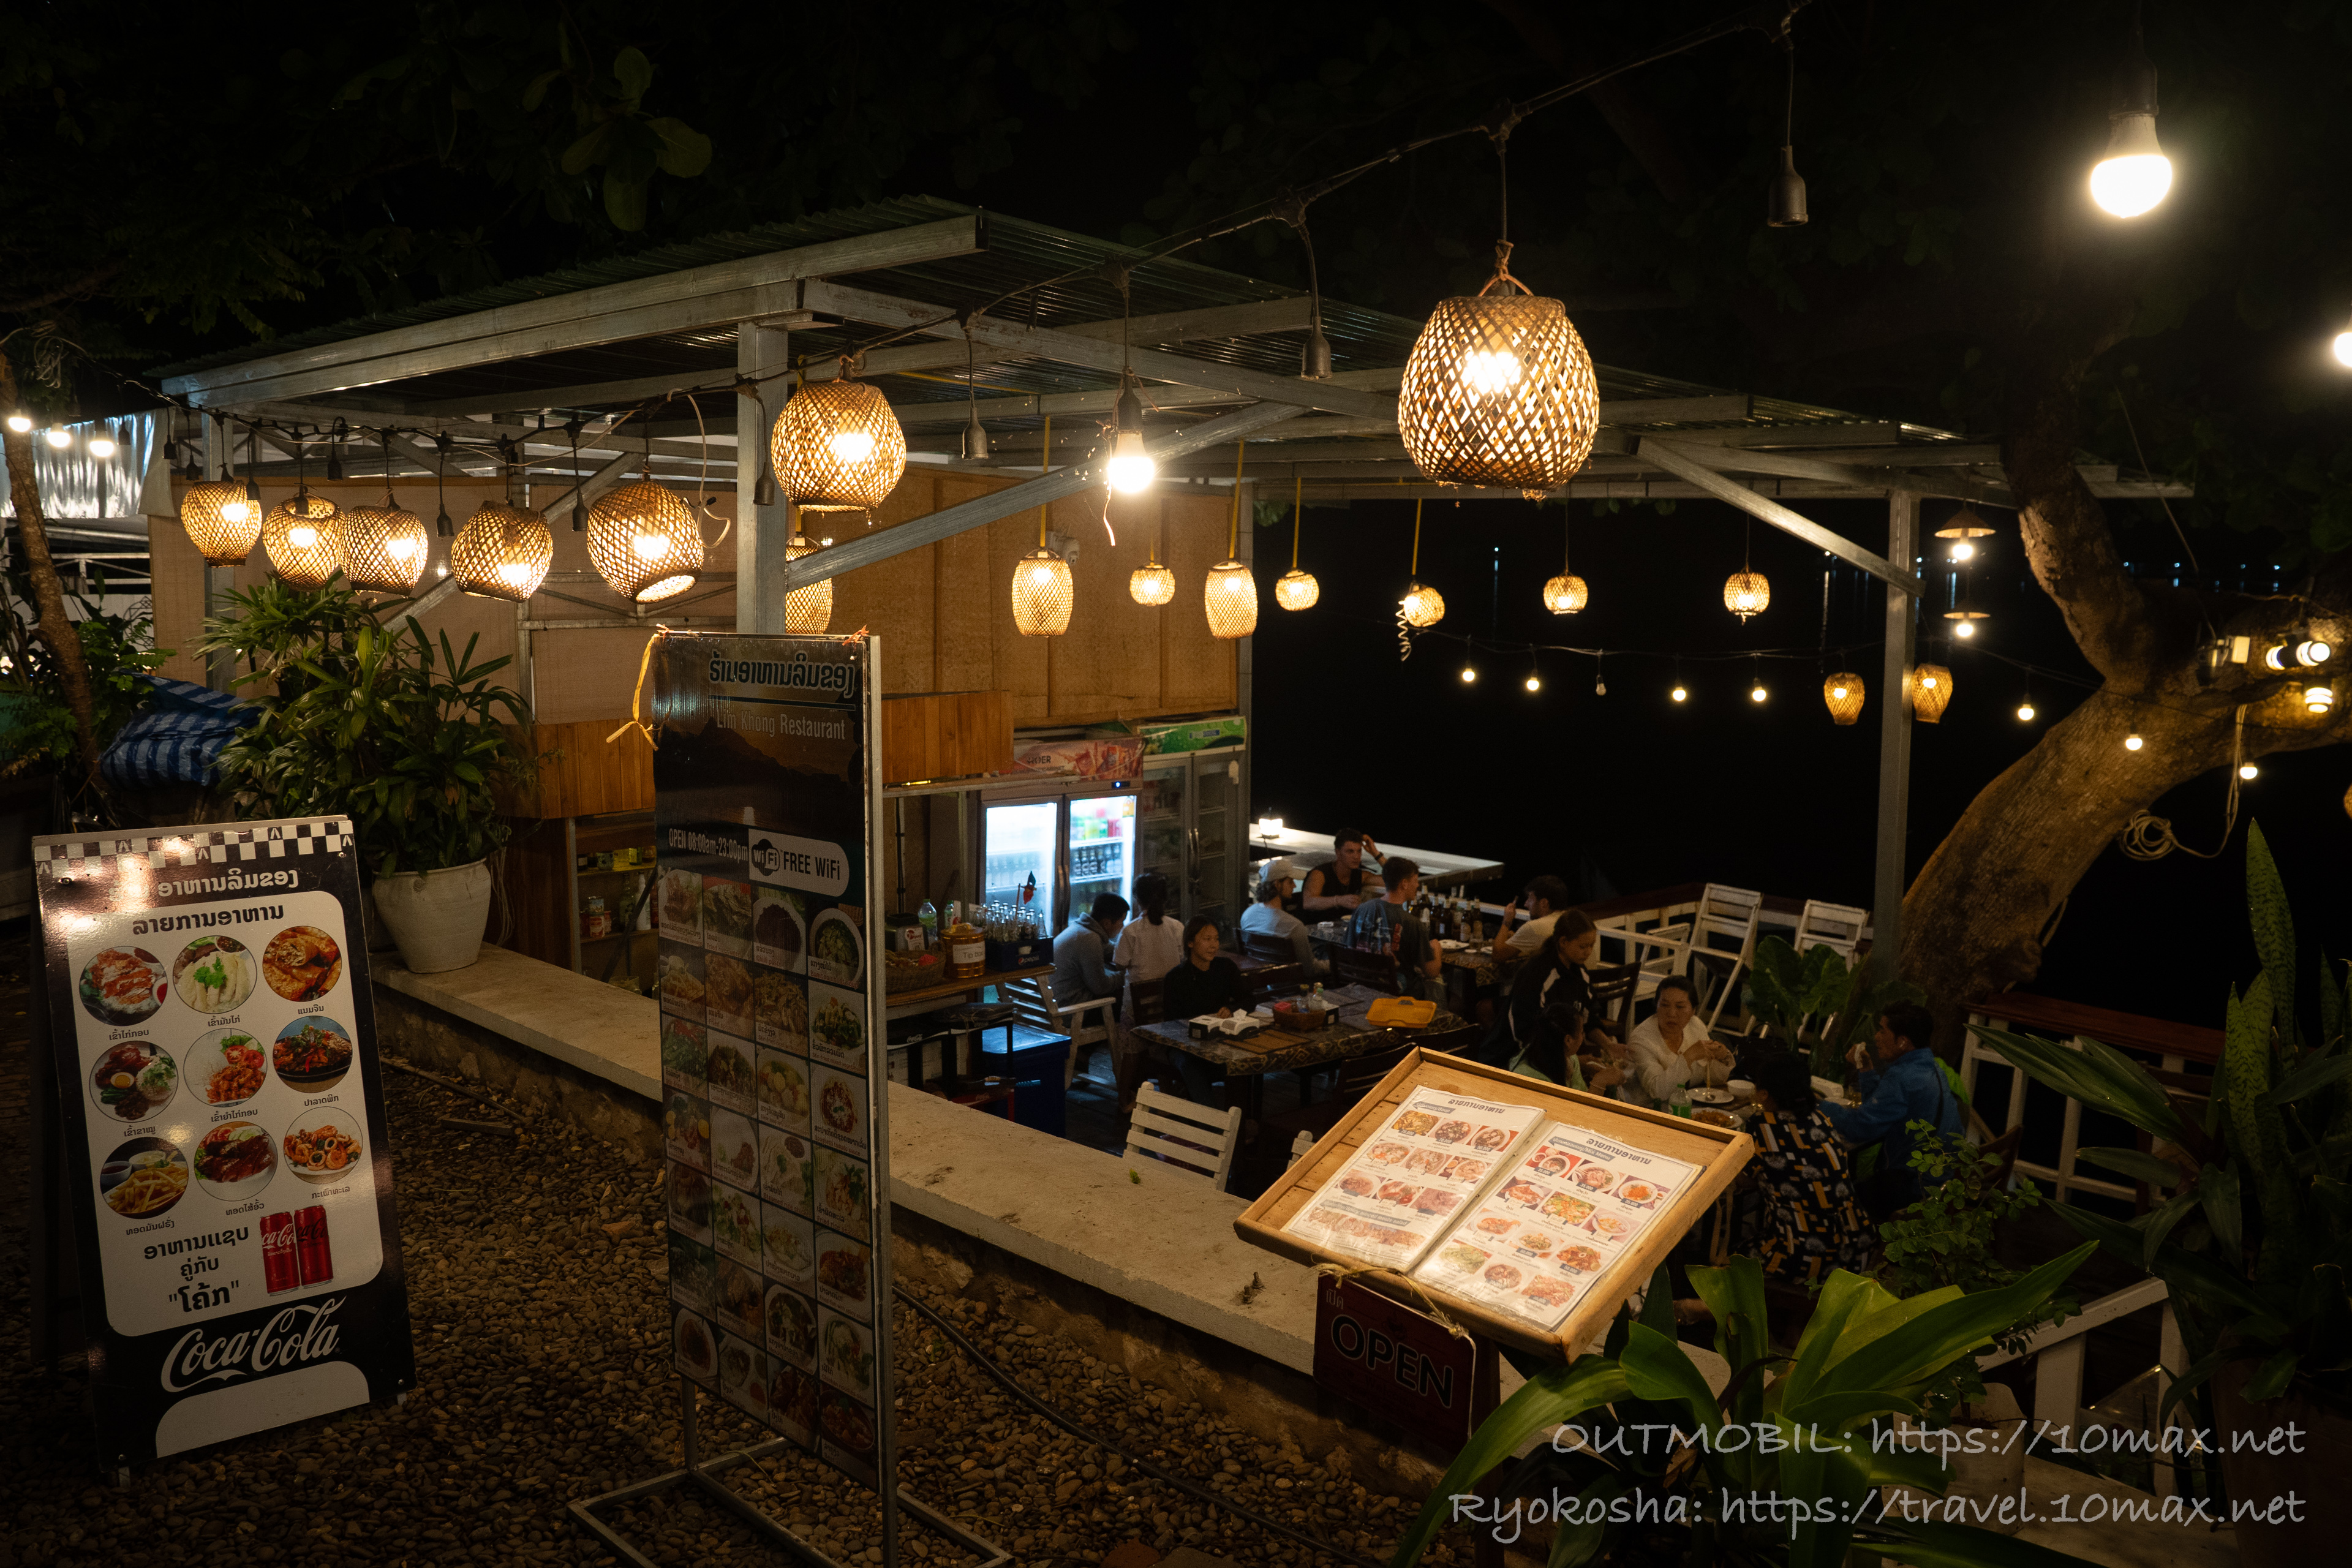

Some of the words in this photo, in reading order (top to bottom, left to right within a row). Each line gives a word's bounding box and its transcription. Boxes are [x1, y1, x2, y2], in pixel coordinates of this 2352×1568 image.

[708, 648, 856, 698] ຮ້ານອາຫານລິມຂອງ
[717, 710, 737, 729] Lim
[741, 710, 775, 737] Khong
[780, 714, 846, 740] Restaurant
[669, 827, 687, 848] OPEN
[688, 831, 748, 862] 08:00am-23:00pm
[783, 851, 811, 875] FREE
[815, 858, 841, 881] WiFi
[157, 867, 299, 897] ອາຫານລິມຂອງ
[132, 905, 284, 935] ລາຍການອາຫານ
[208, 1014, 241, 1027] ເຂົ້າມັນໄກ່
[109, 1028, 149, 1041] ເຂົ້າໄກ່ກອບ
[304, 1093, 339, 1106] ປາລາດພິກ
[1448, 1099, 1506, 1114] ລາຍການອາຫານ
[211, 1109, 258, 1122] ເຂົ້າຍຳໄກ່ກອບ
[124, 1125, 156, 1137] ເຂົ້າຂາໝູ
[1586, 1137, 1652, 1165] ລາຍການອາຫານ
[1595, 1151, 1611, 1161] Menu
[311, 1185, 350, 1199] ກະເພົາທະເລ
[225, 1199, 265, 1216] ທອດໄສ້ອົ້ວ
[126, 1216, 175, 1235] ທອດມັນຝຣັ່ງ
[144, 1226, 249, 1259] ອາຫານແຊບ
[181, 1256, 219, 1281] ຄູ່ກັບ
[168, 1280, 239, 1312] "ໂຄ້ກ"
[160, 1295, 347, 1393] Coca-Cola
[1331, 1314, 1454, 1409] OPEN
